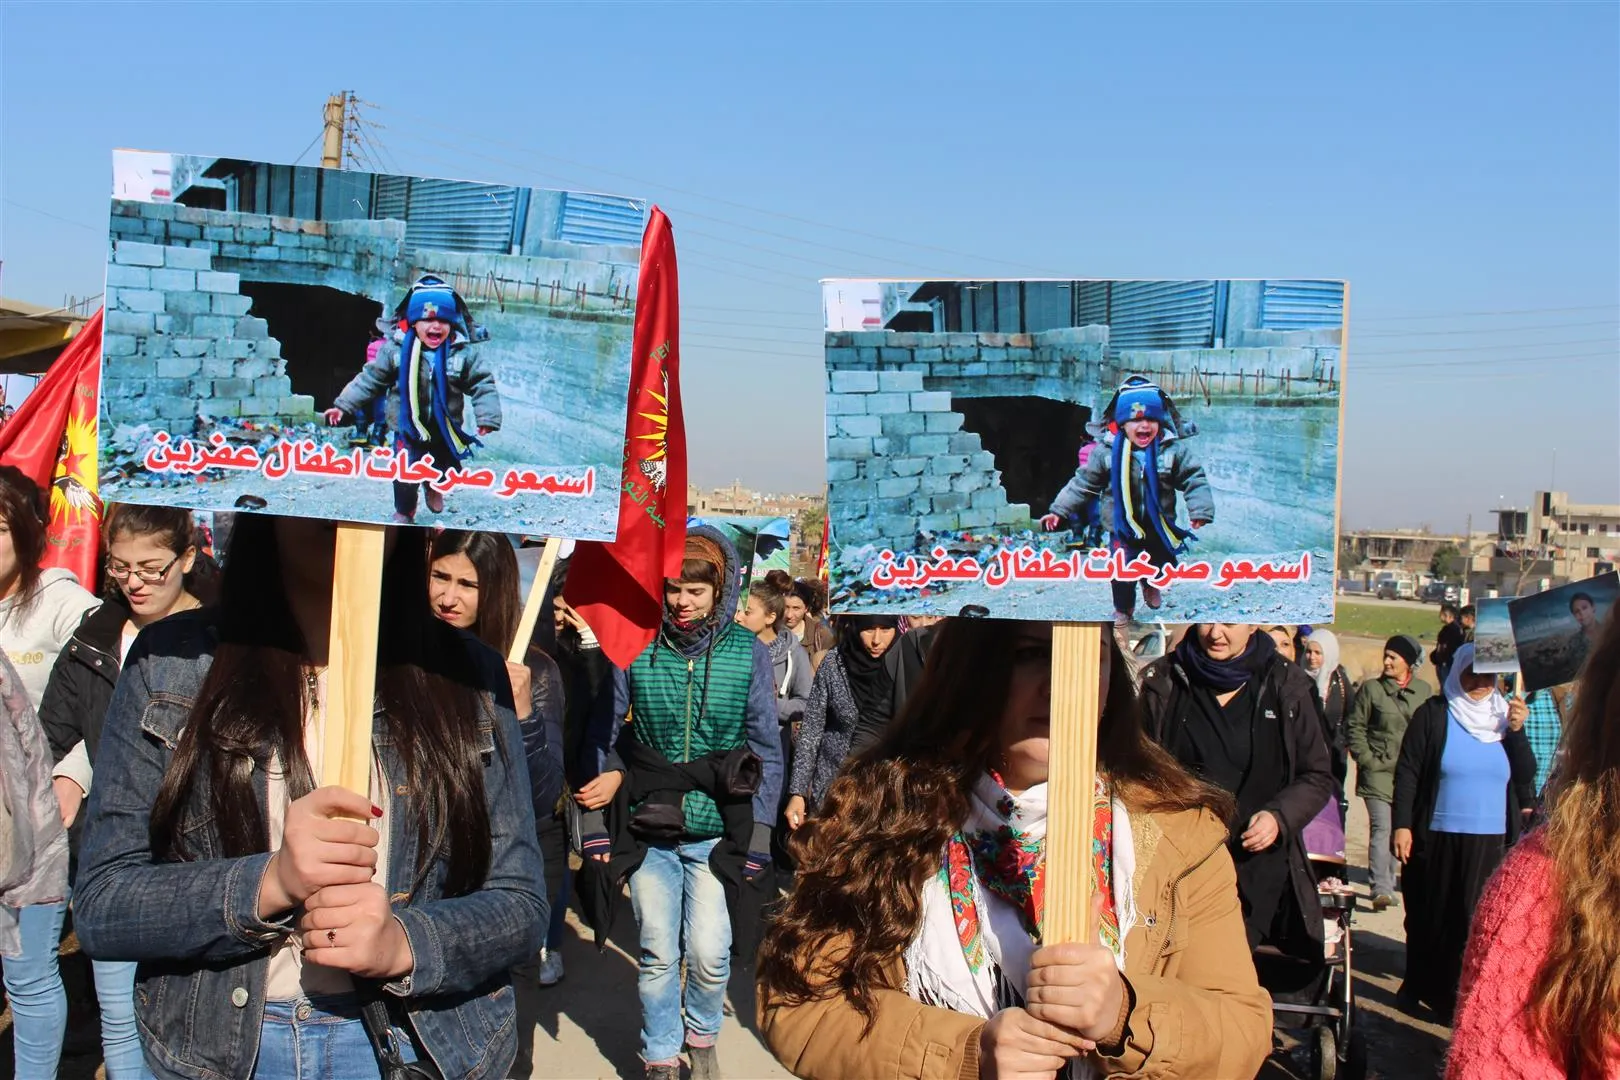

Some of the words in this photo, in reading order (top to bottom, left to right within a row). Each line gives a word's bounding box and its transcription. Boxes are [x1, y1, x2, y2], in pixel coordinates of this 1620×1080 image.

[146, 432, 260, 472] عفرين
[264, 440, 360, 478] اطفال
[365, 449, 494, 492] صرخات
[496, 467, 594, 497] اسمعو
[872, 547, 981, 586] عفرين
[986, 549, 1079, 586] اطفال
[1083, 549, 1210, 587] صرخات
[1211, 553, 1309, 588] اسمعو
